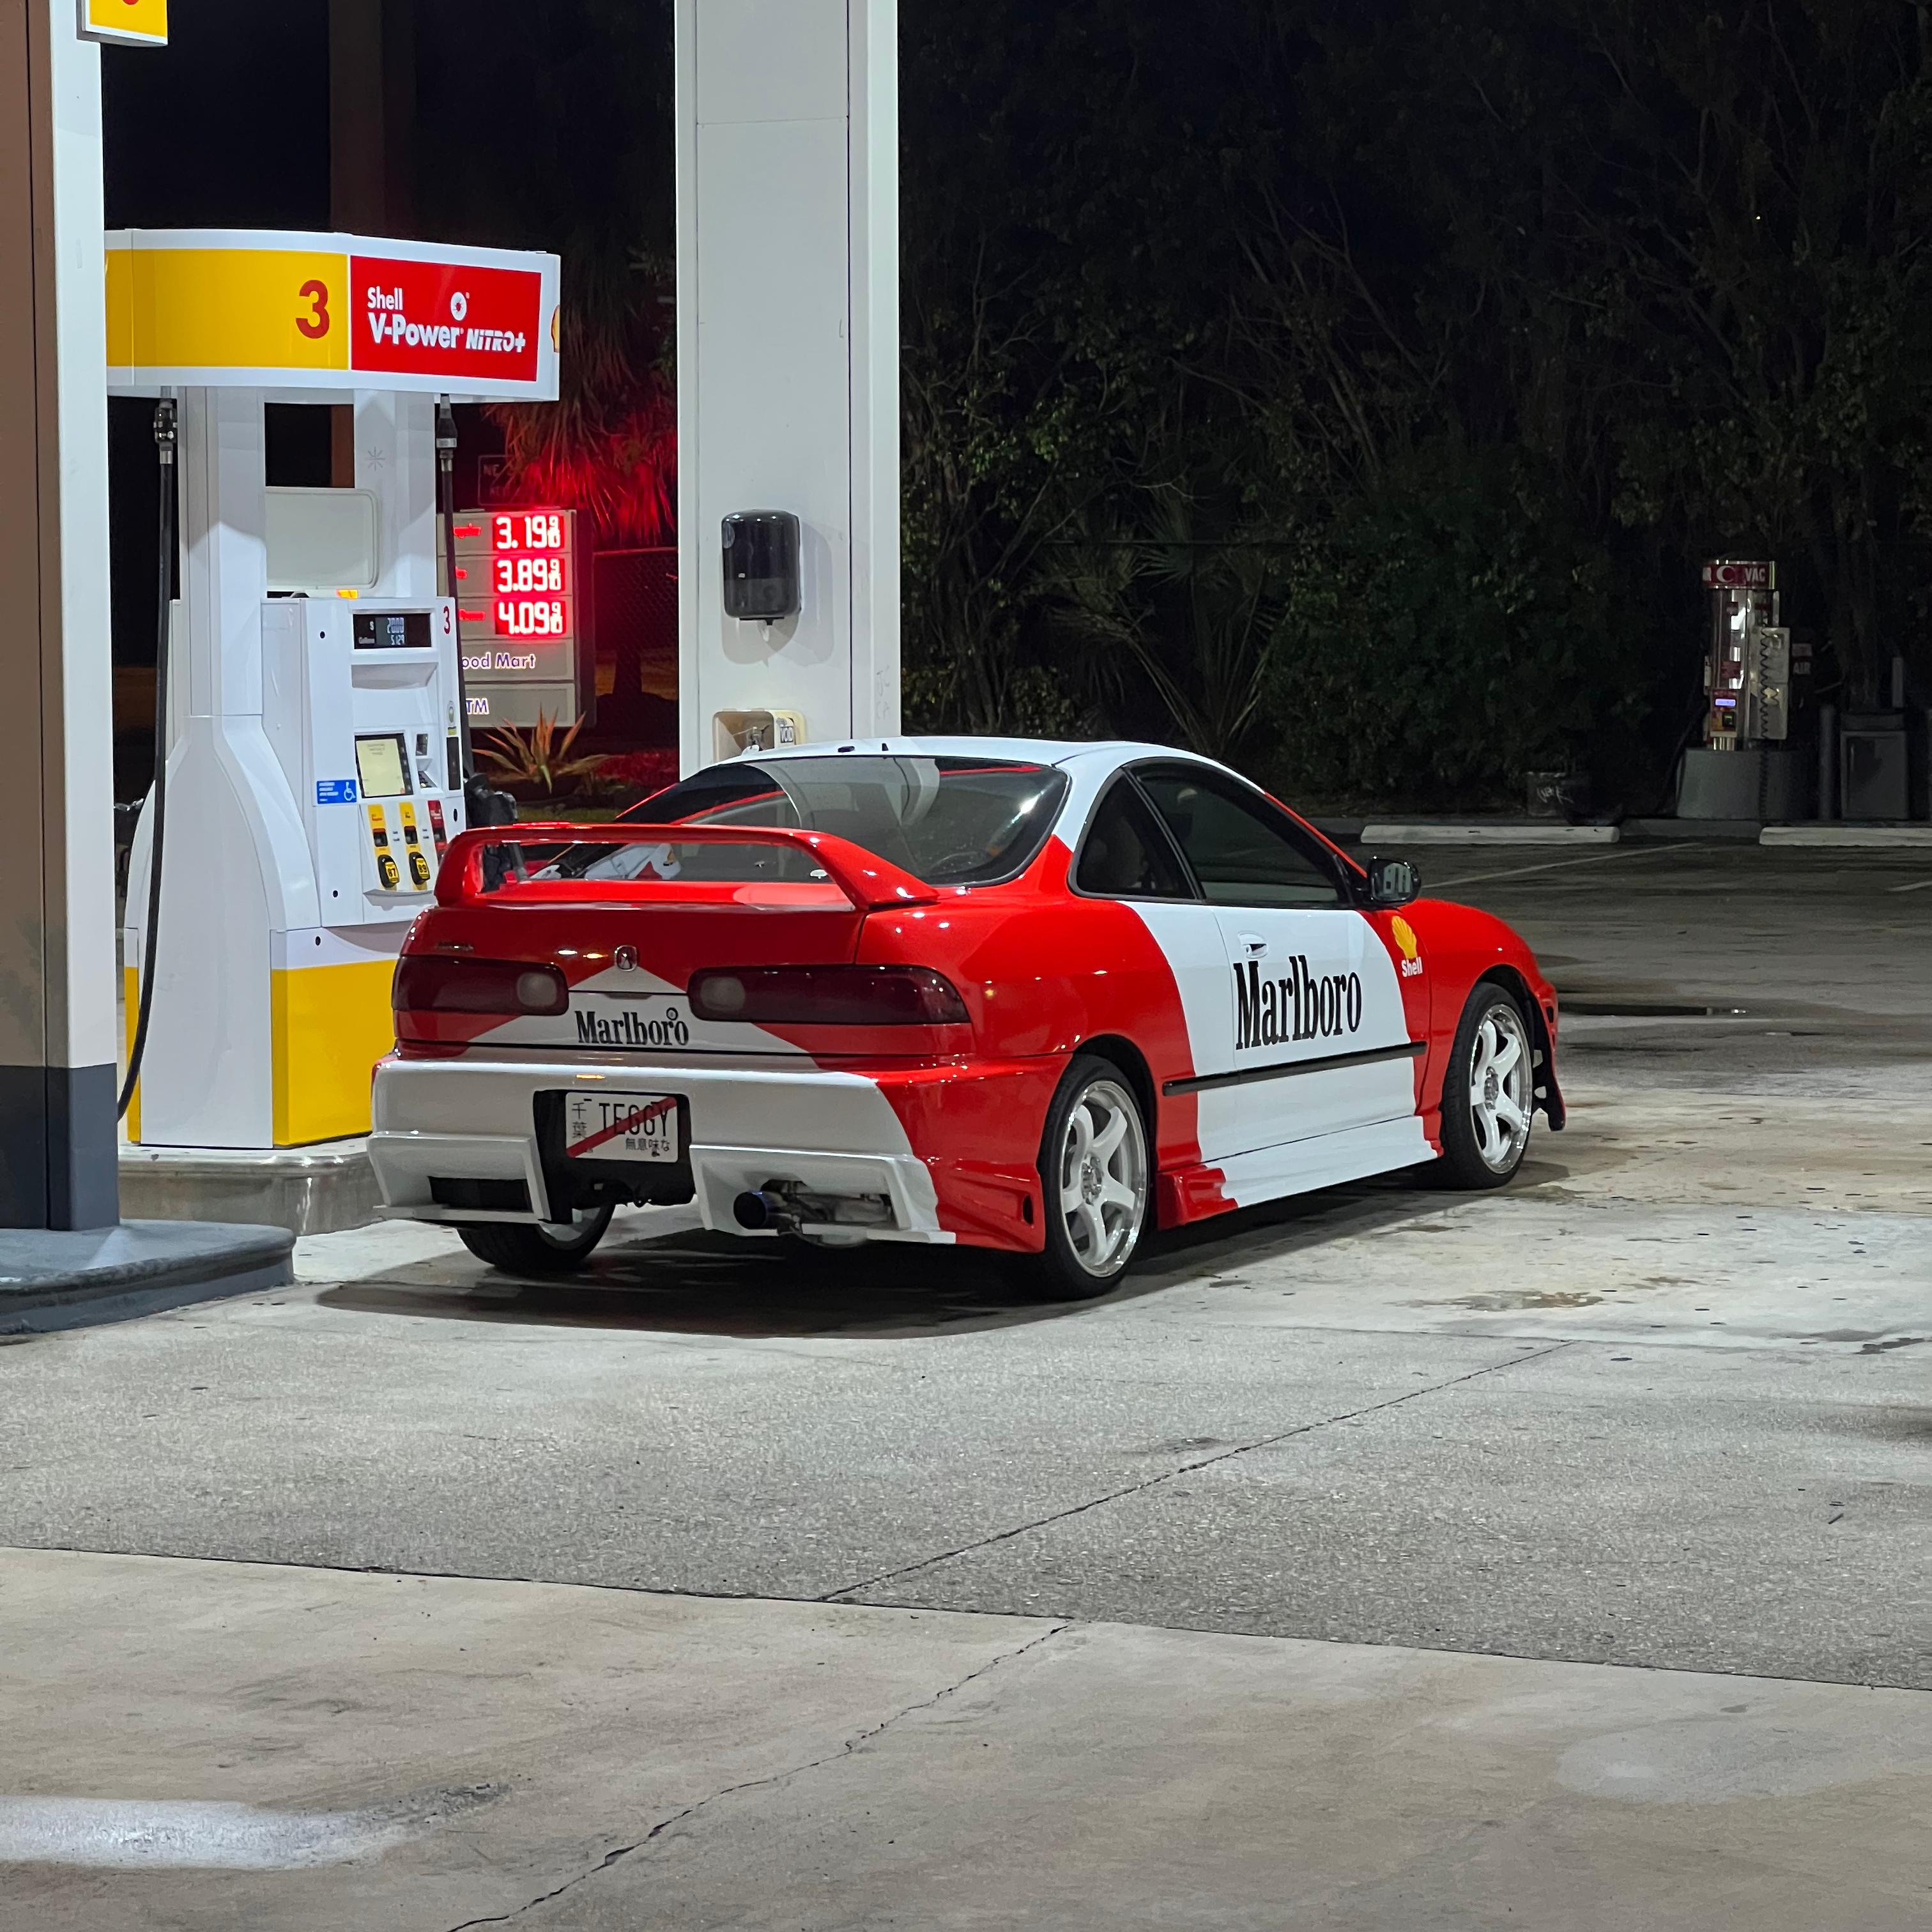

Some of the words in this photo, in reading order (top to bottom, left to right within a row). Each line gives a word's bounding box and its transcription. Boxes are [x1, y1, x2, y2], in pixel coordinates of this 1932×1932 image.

[296, 279, 330, 339] 3
[367, 286, 403, 310] Shell
[368, 312, 459, 349] V-Power
[1745, 567, 1766, 582] VAC
[443, 606, 450, 634] 3
[462, 652, 491, 670] ood
[495, 652, 536, 669] Mart
[1793, 662, 1811, 675] AIR
[466, 698, 490, 715] TM
[1400, 956, 1423, 977] Shell
[1233, 954, 1362, 1050] Marlboro
[575, 1010, 689, 1046] Marlboro
[572, 1102, 586, 1139] 千葉
[599, 1103, 670, 1137] TEGGY
